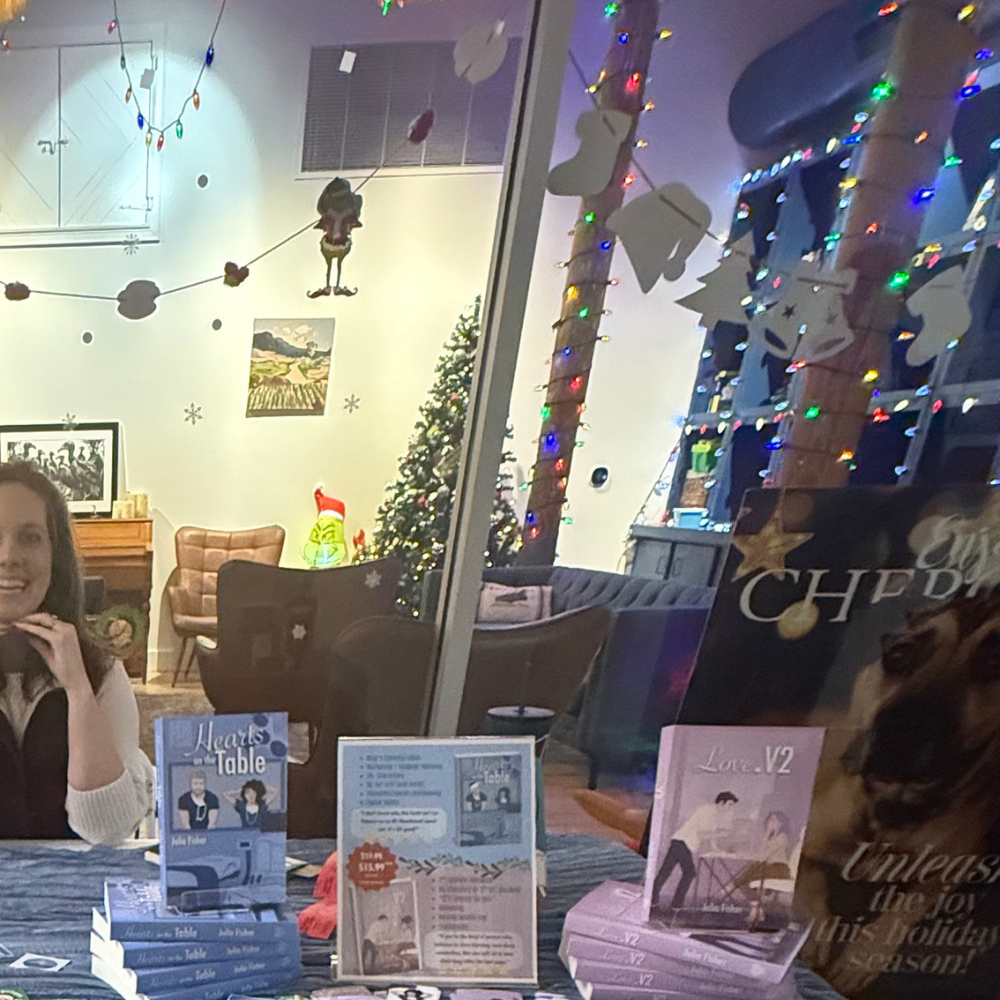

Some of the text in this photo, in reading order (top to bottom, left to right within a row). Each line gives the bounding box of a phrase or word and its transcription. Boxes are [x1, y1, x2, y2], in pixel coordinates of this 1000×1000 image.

[184, 720, 265, 757] Hearts
[215, 746, 266, 775] Table
[172, 836, 206, 847] Julia Fisher
[841, 841, 1000, 884] Unleas
[175, 927, 197, 938] Table
[186, 948, 207, 960] Table
